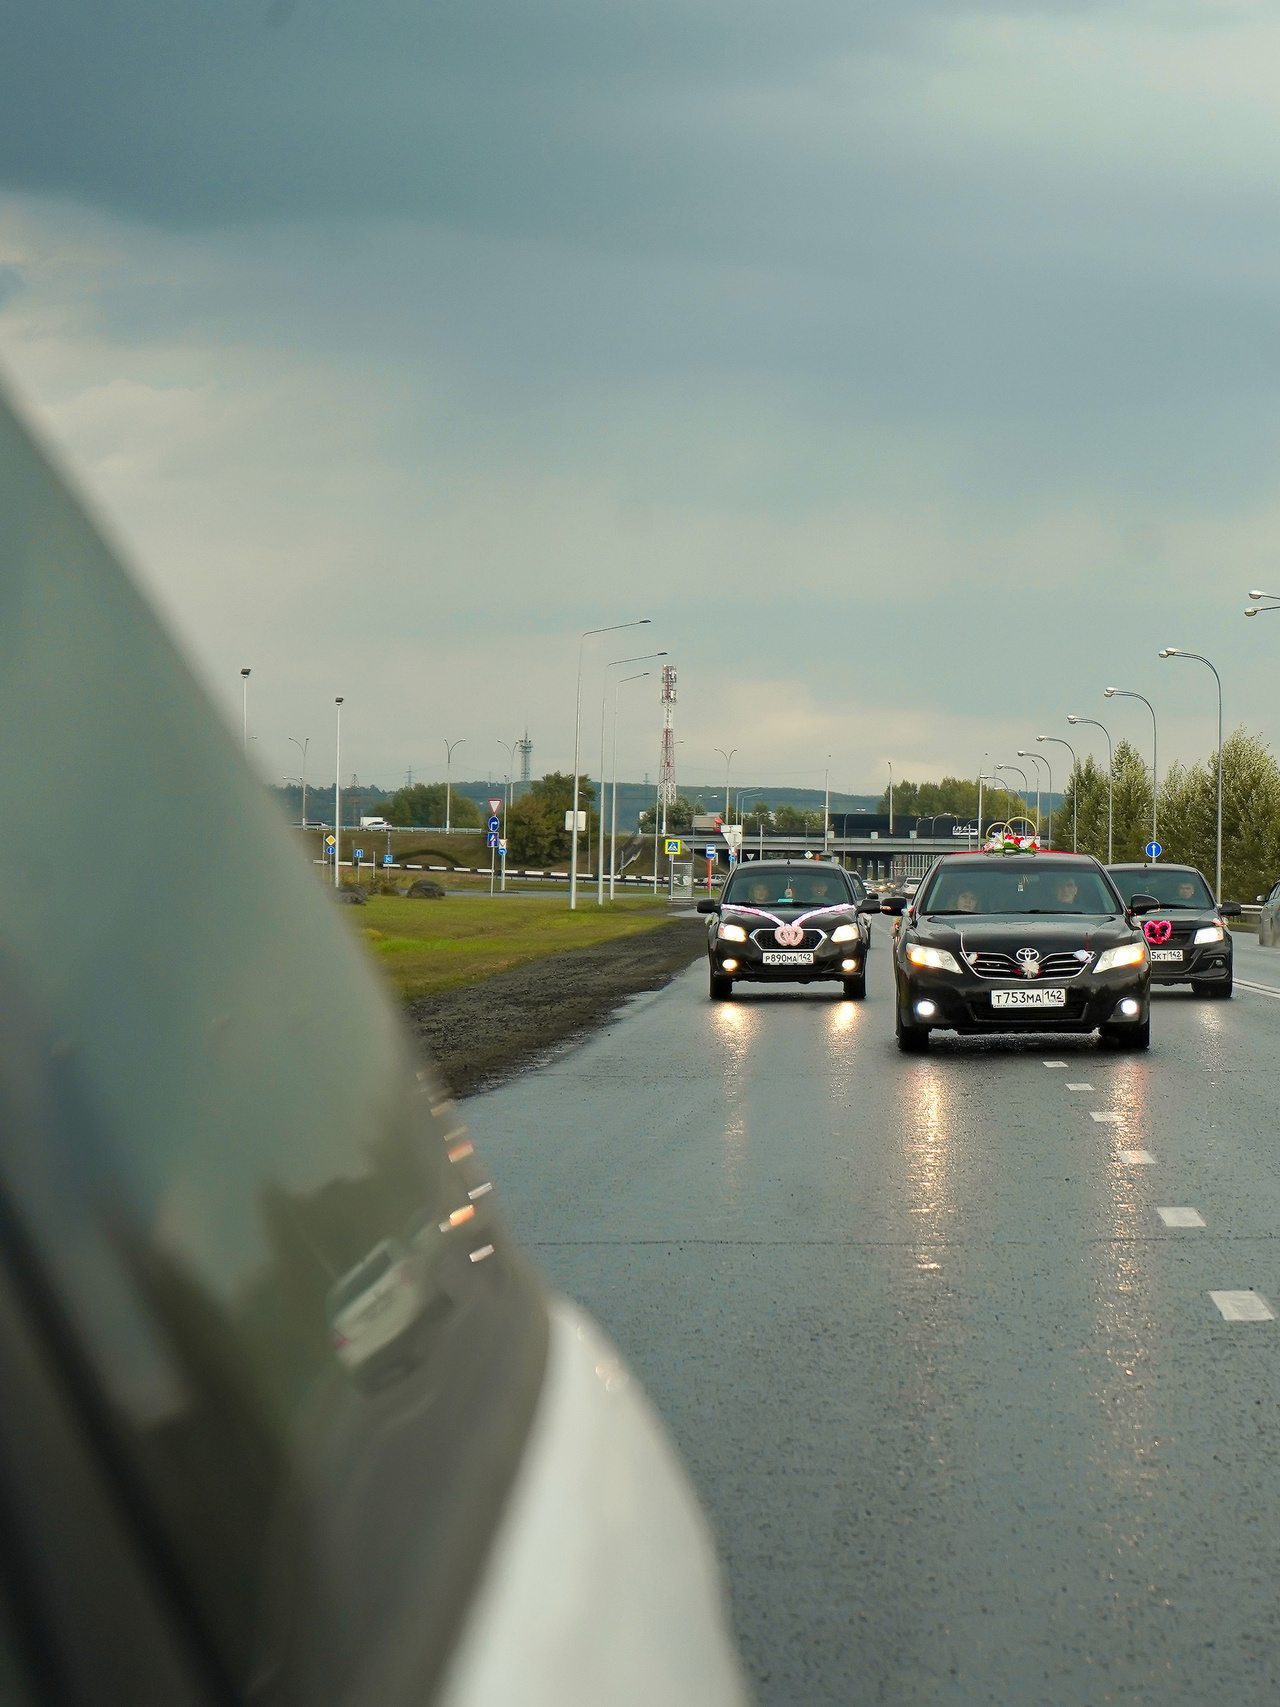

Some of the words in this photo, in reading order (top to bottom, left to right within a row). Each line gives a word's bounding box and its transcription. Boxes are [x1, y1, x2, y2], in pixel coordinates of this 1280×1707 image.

[765, 954, 797, 962] Р890МА
[1168, 950, 1181, 958] 142
[996, 992, 1042, 1003] Т753МА
[1044, 990, 1062, 1000] 142
